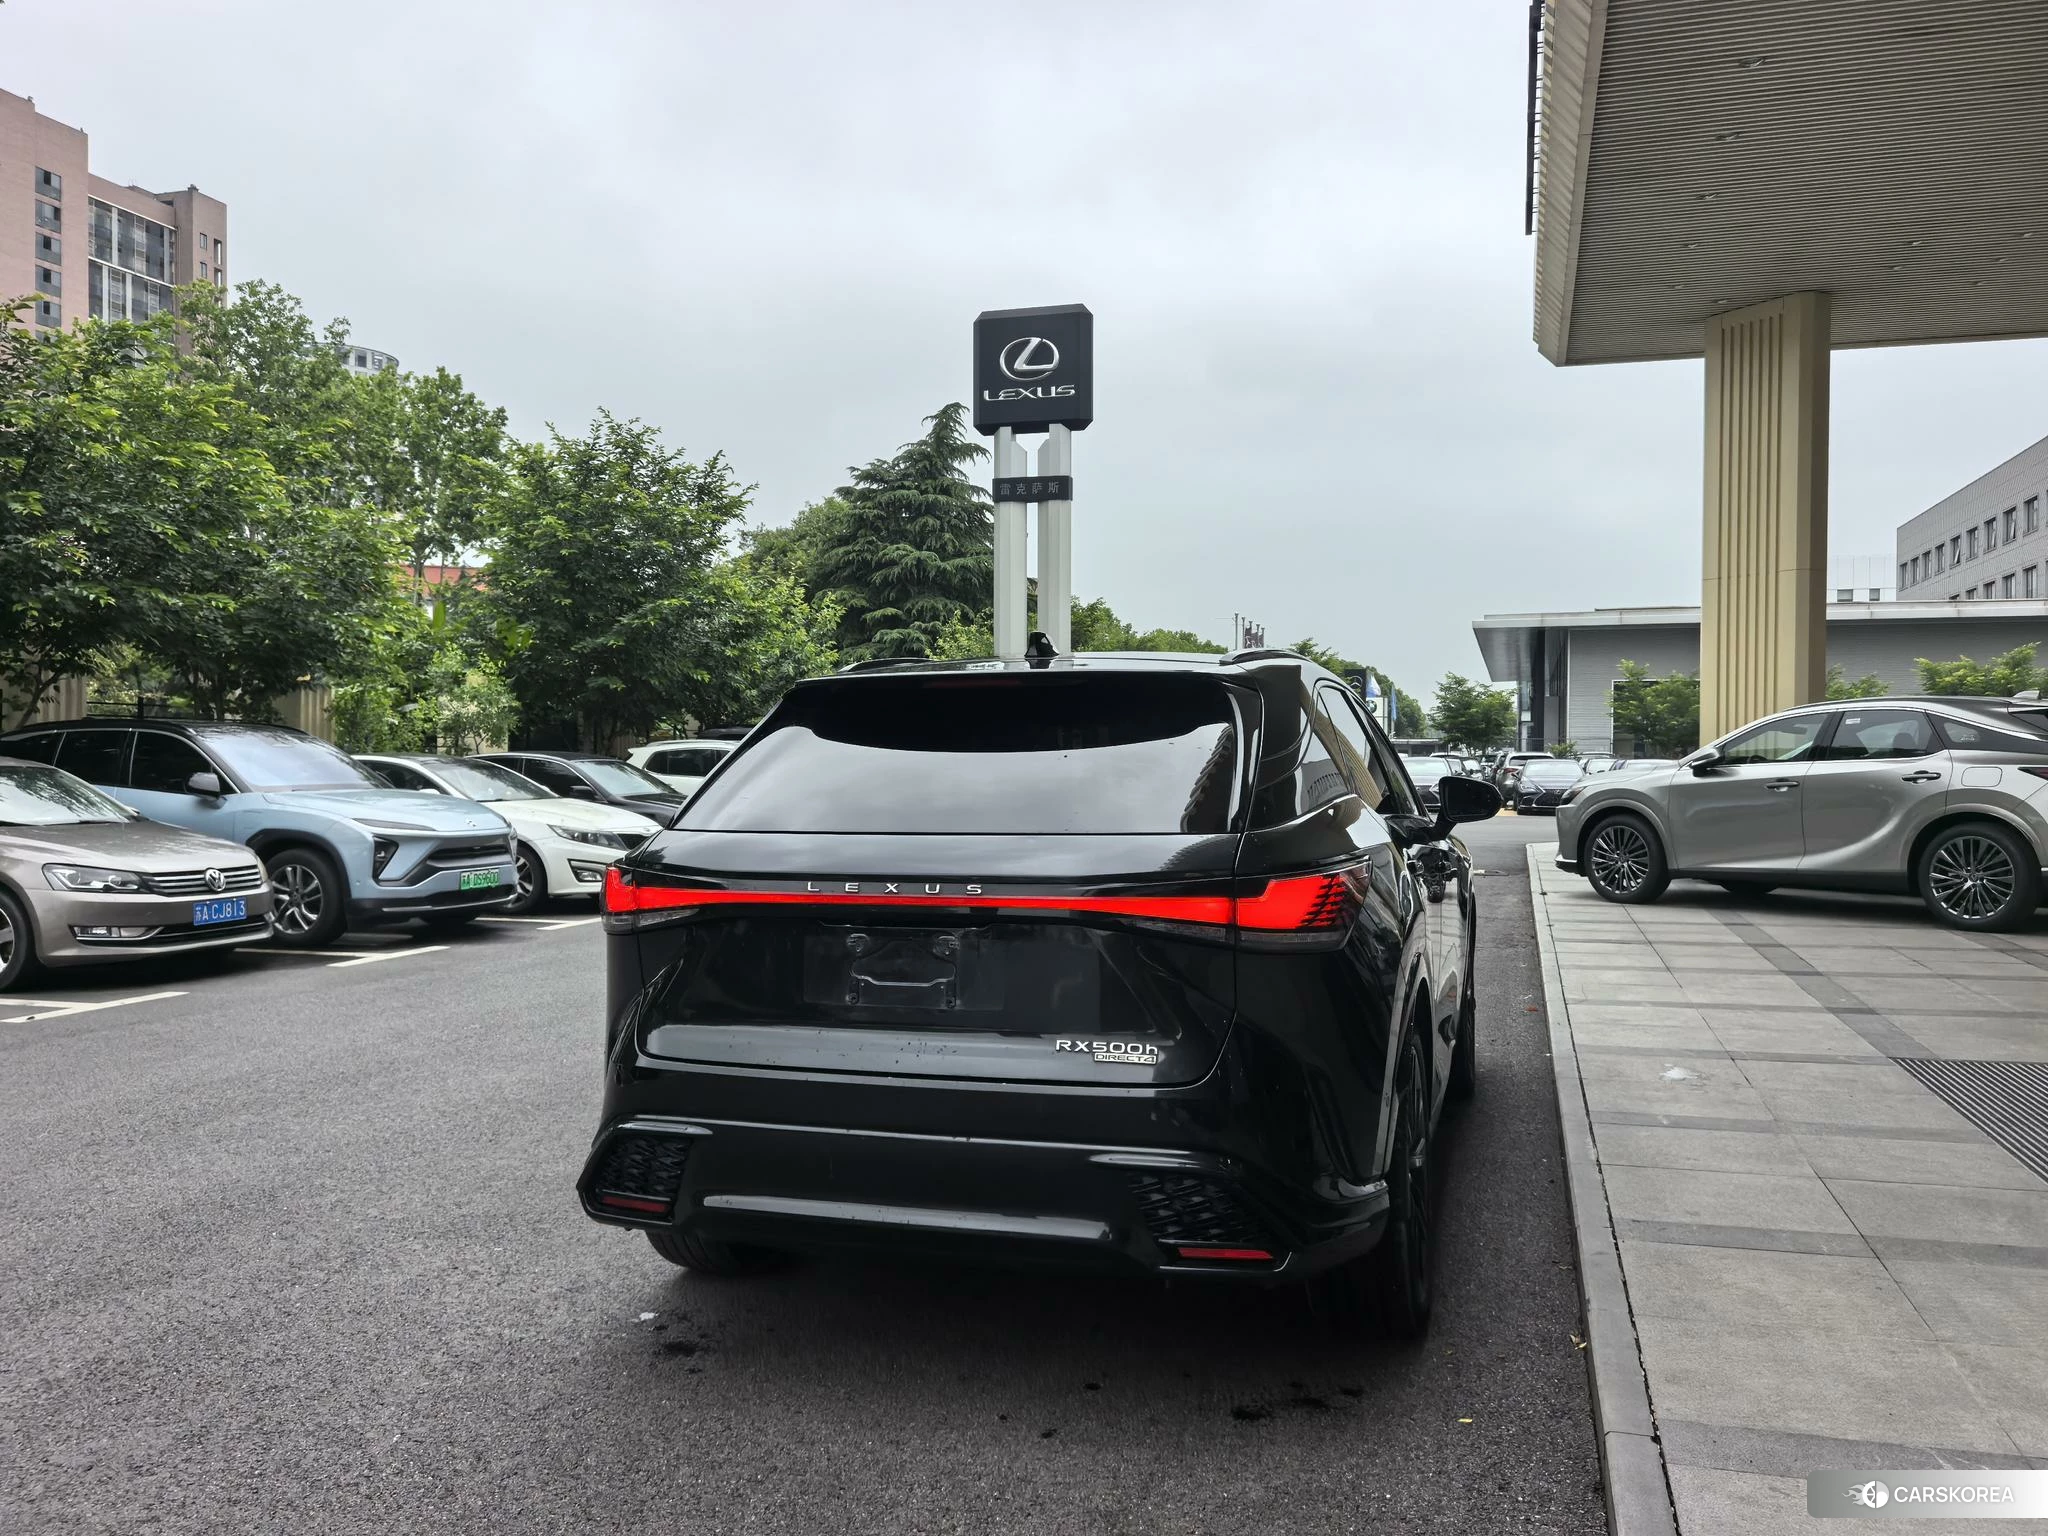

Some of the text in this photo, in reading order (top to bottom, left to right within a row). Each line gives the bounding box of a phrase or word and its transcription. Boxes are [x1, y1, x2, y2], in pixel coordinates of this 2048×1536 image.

[983, 384, 1075, 401] LEXUS
[1000, 482, 1060, 495] 雷克萨斯
[807, 882, 982, 894] LEXUS
[1055, 1039, 1159, 1056] RX500h
[1095, 1053, 1155, 1064] DIRECT4
